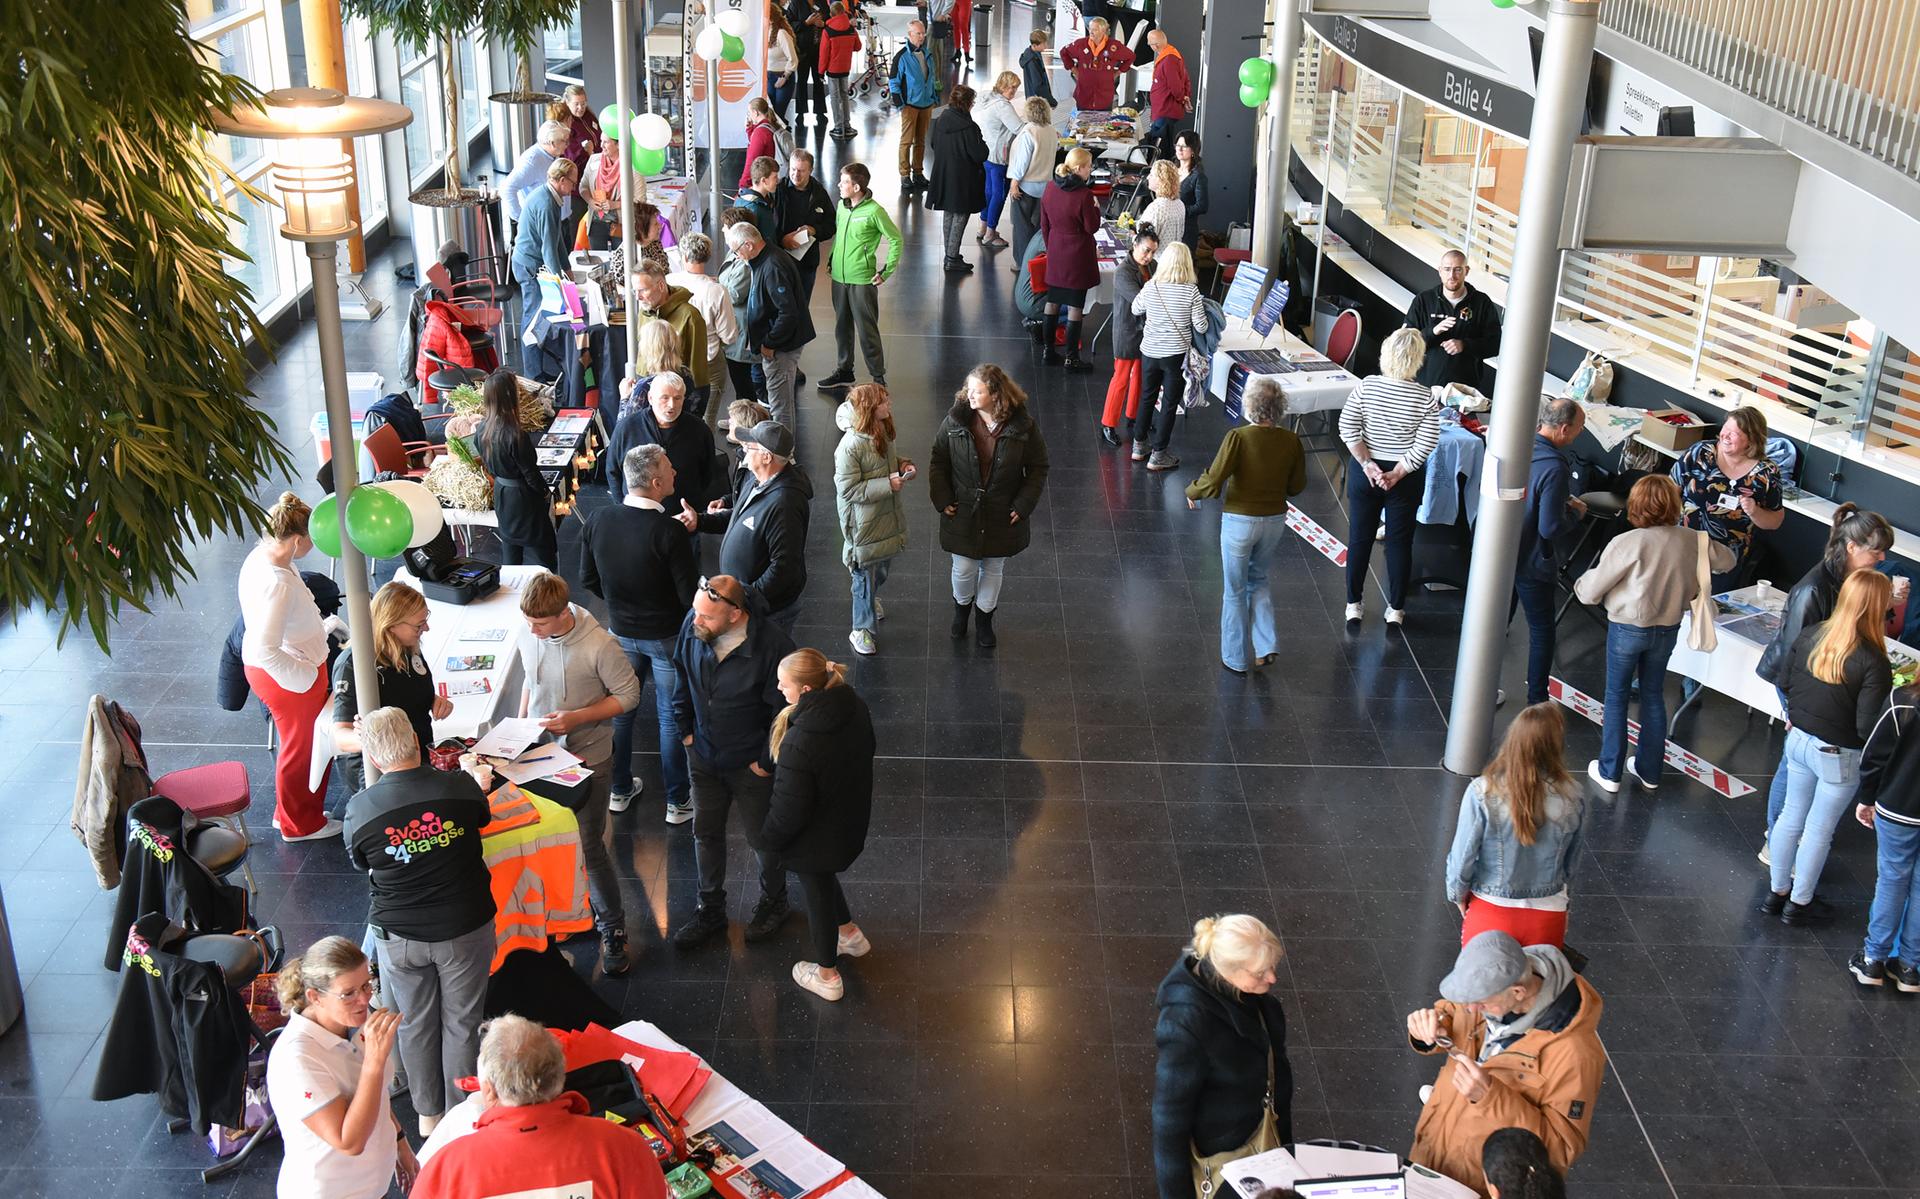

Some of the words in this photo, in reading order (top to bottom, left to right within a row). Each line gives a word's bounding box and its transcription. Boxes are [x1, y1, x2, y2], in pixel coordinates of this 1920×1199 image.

[1334, 16, 1350, 49] Balie
[1351, 28, 1358, 53] 3
[1444, 71, 1479, 111] Balie
[1482, 88, 1493, 117] 4
[1625, 81, 1660, 112] Spreekkamers
[1623, 101, 1643, 122] Toiletten
[1678, 757, 1707, 772] elkaar
[389, 816, 443, 846] avond
